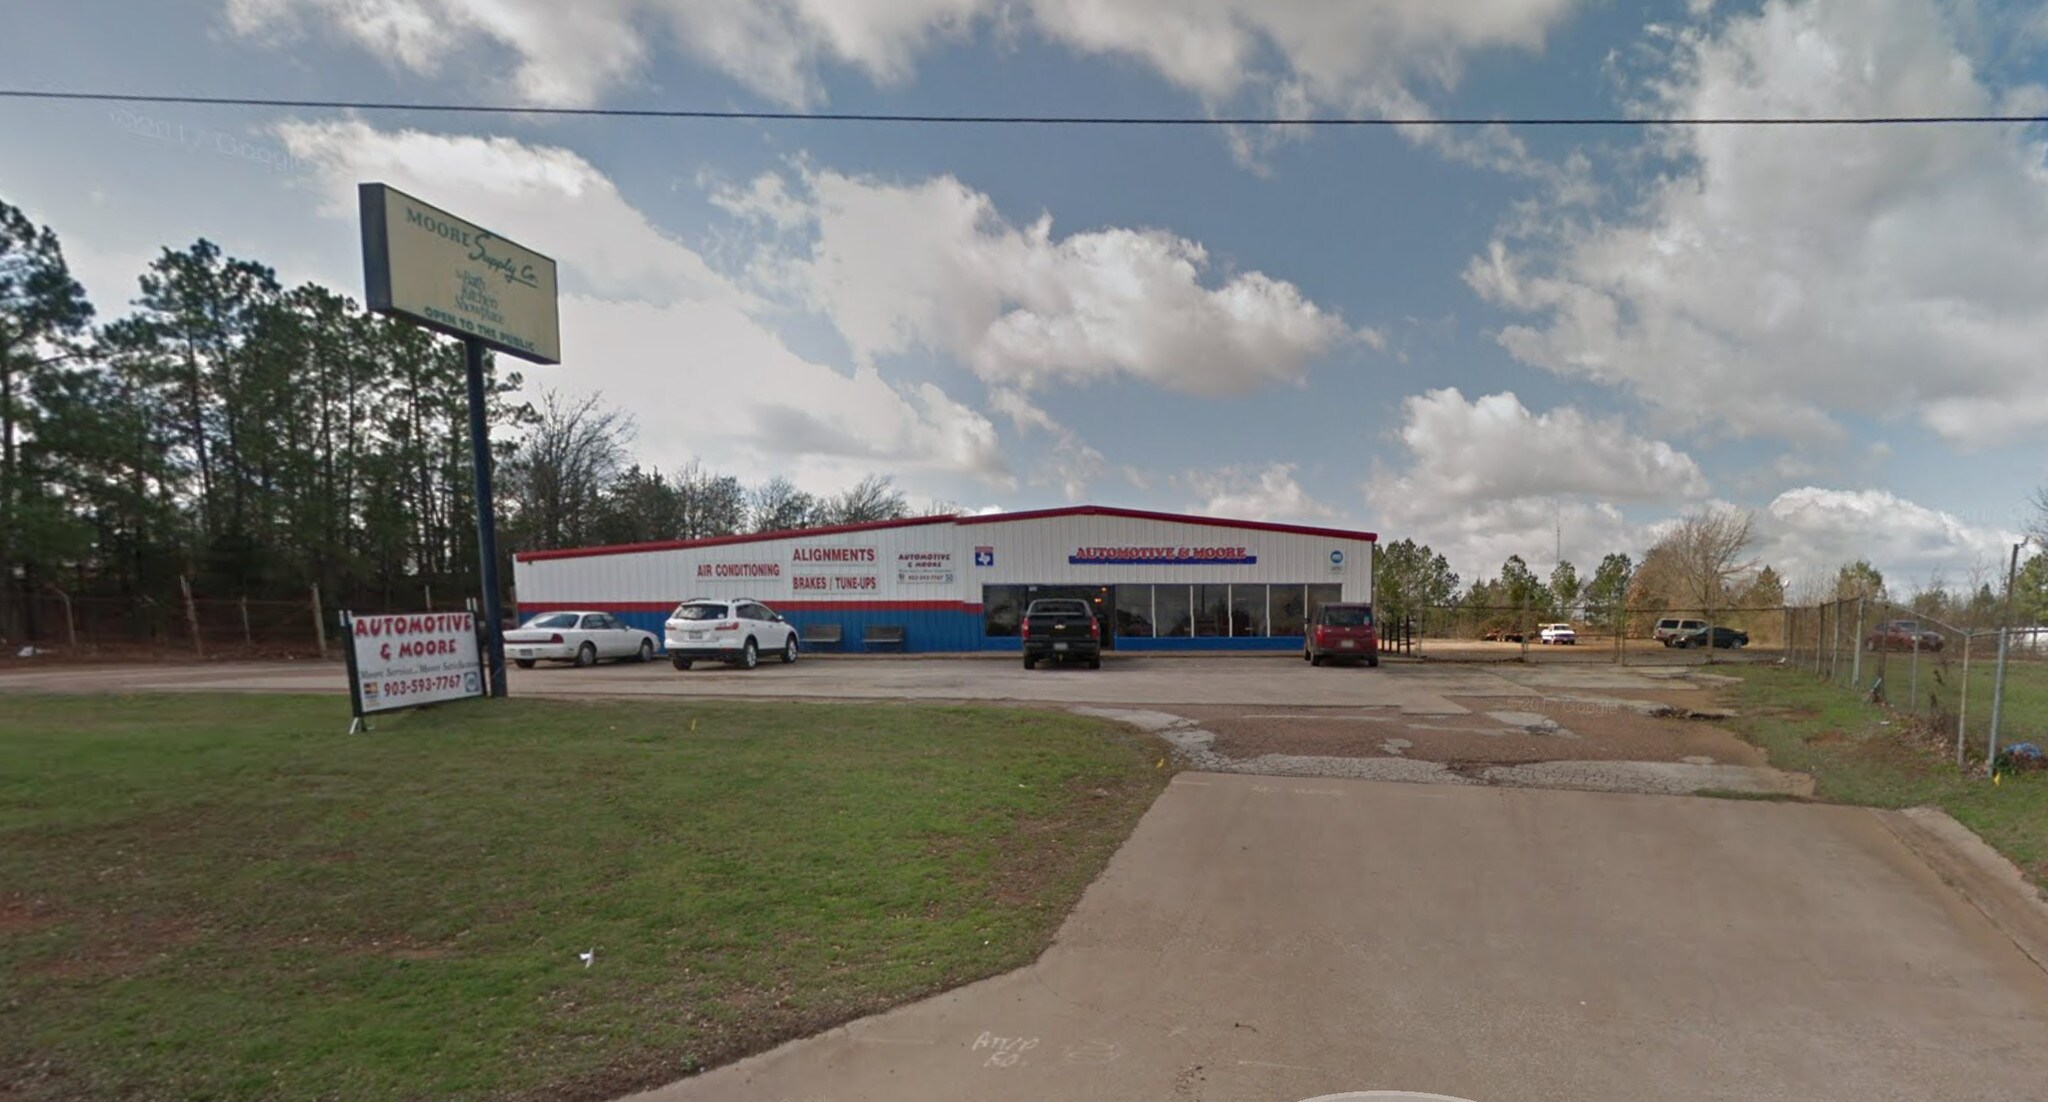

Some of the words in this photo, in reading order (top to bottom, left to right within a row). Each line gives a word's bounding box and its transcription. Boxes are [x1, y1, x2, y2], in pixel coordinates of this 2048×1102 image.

[406, 206, 470, 247] MOORE
[468, 232, 516, 285] Supply
[424, 306, 457, 324] OPEN
[459, 319, 474, 332] TO
[478, 324, 497, 339] THE
[500, 332, 535, 352] PUBLIC
[793, 548, 875, 561] ALIGNMENTS
[898, 553, 951, 561] AUTOMOTIVE
[1076, 547, 1175, 559] AUTOMOTIVE
[1177, 547, 1190, 558] &
[1193, 548, 1247, 559] MOORE
[697, 564, 712, 577] AIR
[715, 563, 780, 577] CONDITIONING
[793, 577, 827, 590] BRAKES
[835, 577, 876, 590] TUNE-UPS
[355, 614, 472, 637] AUTOMOTIVE
[399, 639, 457, 658] MOORE
[384, 674, 461, 697] 903-593-7767
